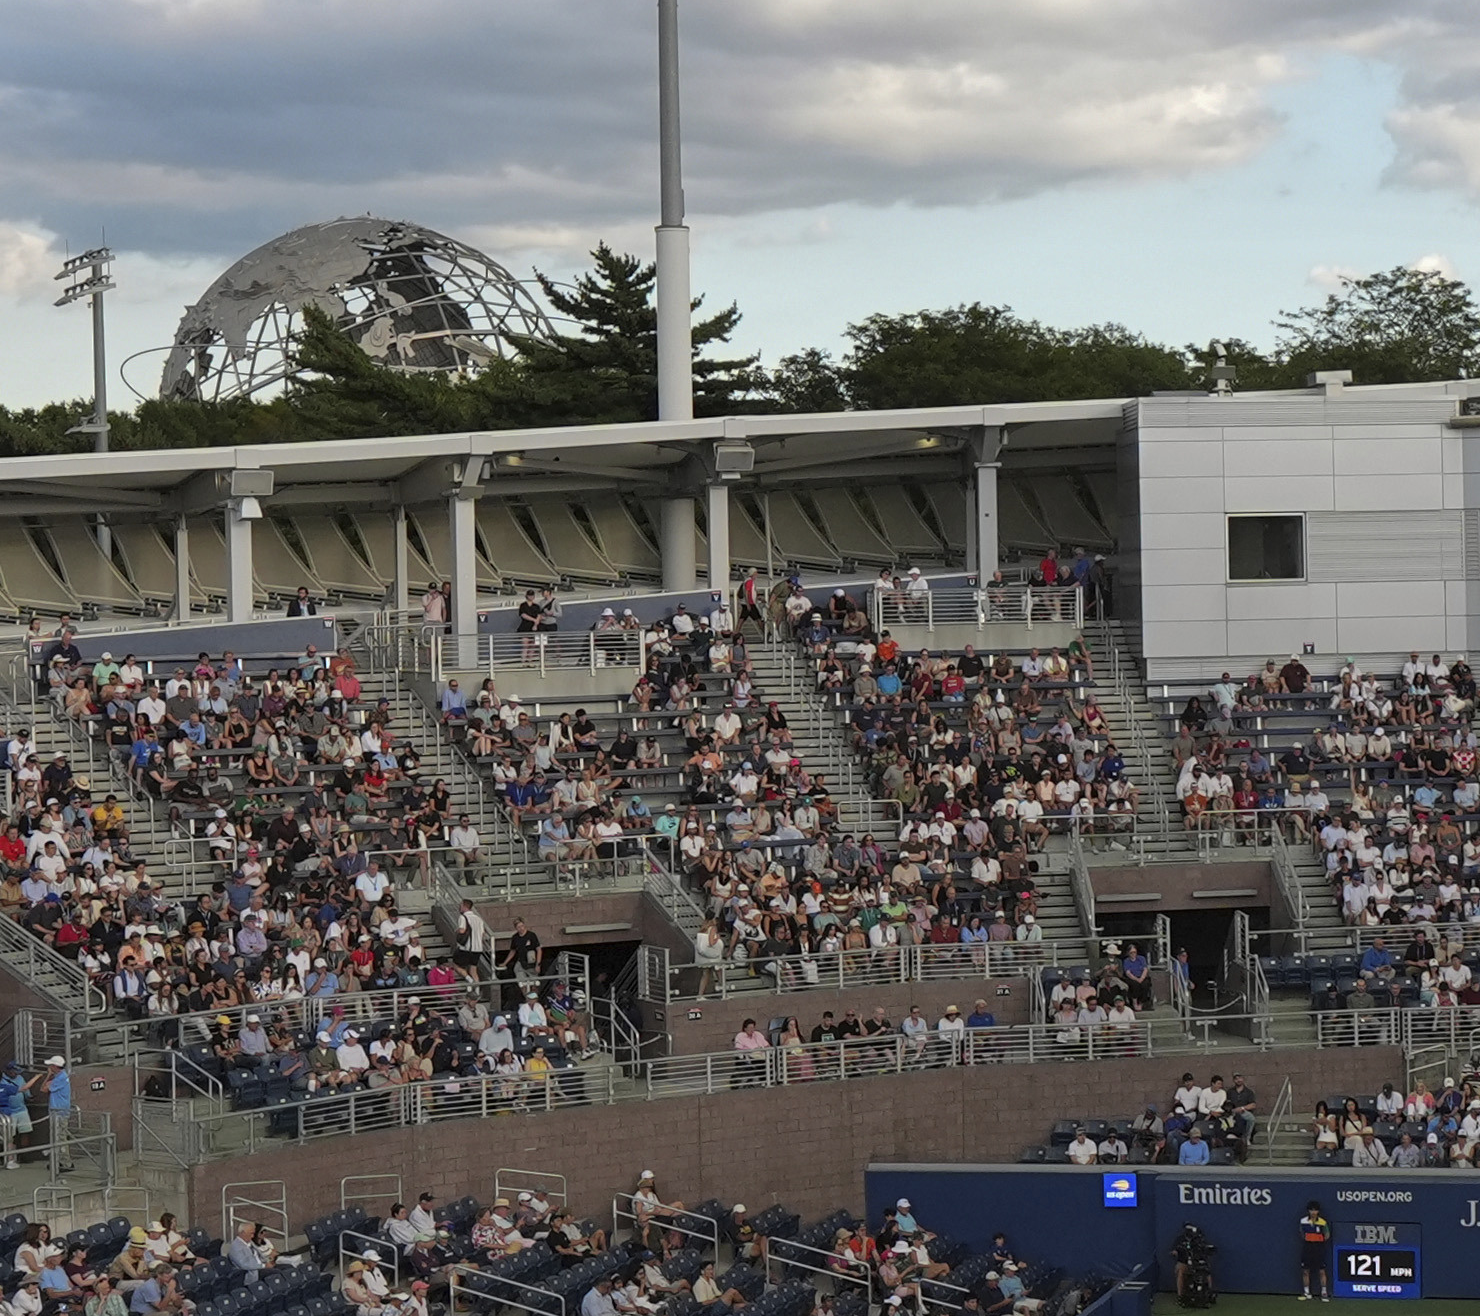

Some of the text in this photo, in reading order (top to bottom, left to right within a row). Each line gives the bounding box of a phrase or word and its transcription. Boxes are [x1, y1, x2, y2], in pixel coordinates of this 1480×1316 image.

[1178, 1183, 1272, 1205] Emirates
[1336, 1190, 1413, 1203] USOPEN.ORG
[1354, 1225, 1398, 1244] IBM
[1347, 1254, 1413, 1277] 121 MPH
[1352, 1284, 1402, 1293] SERVE SPEED
